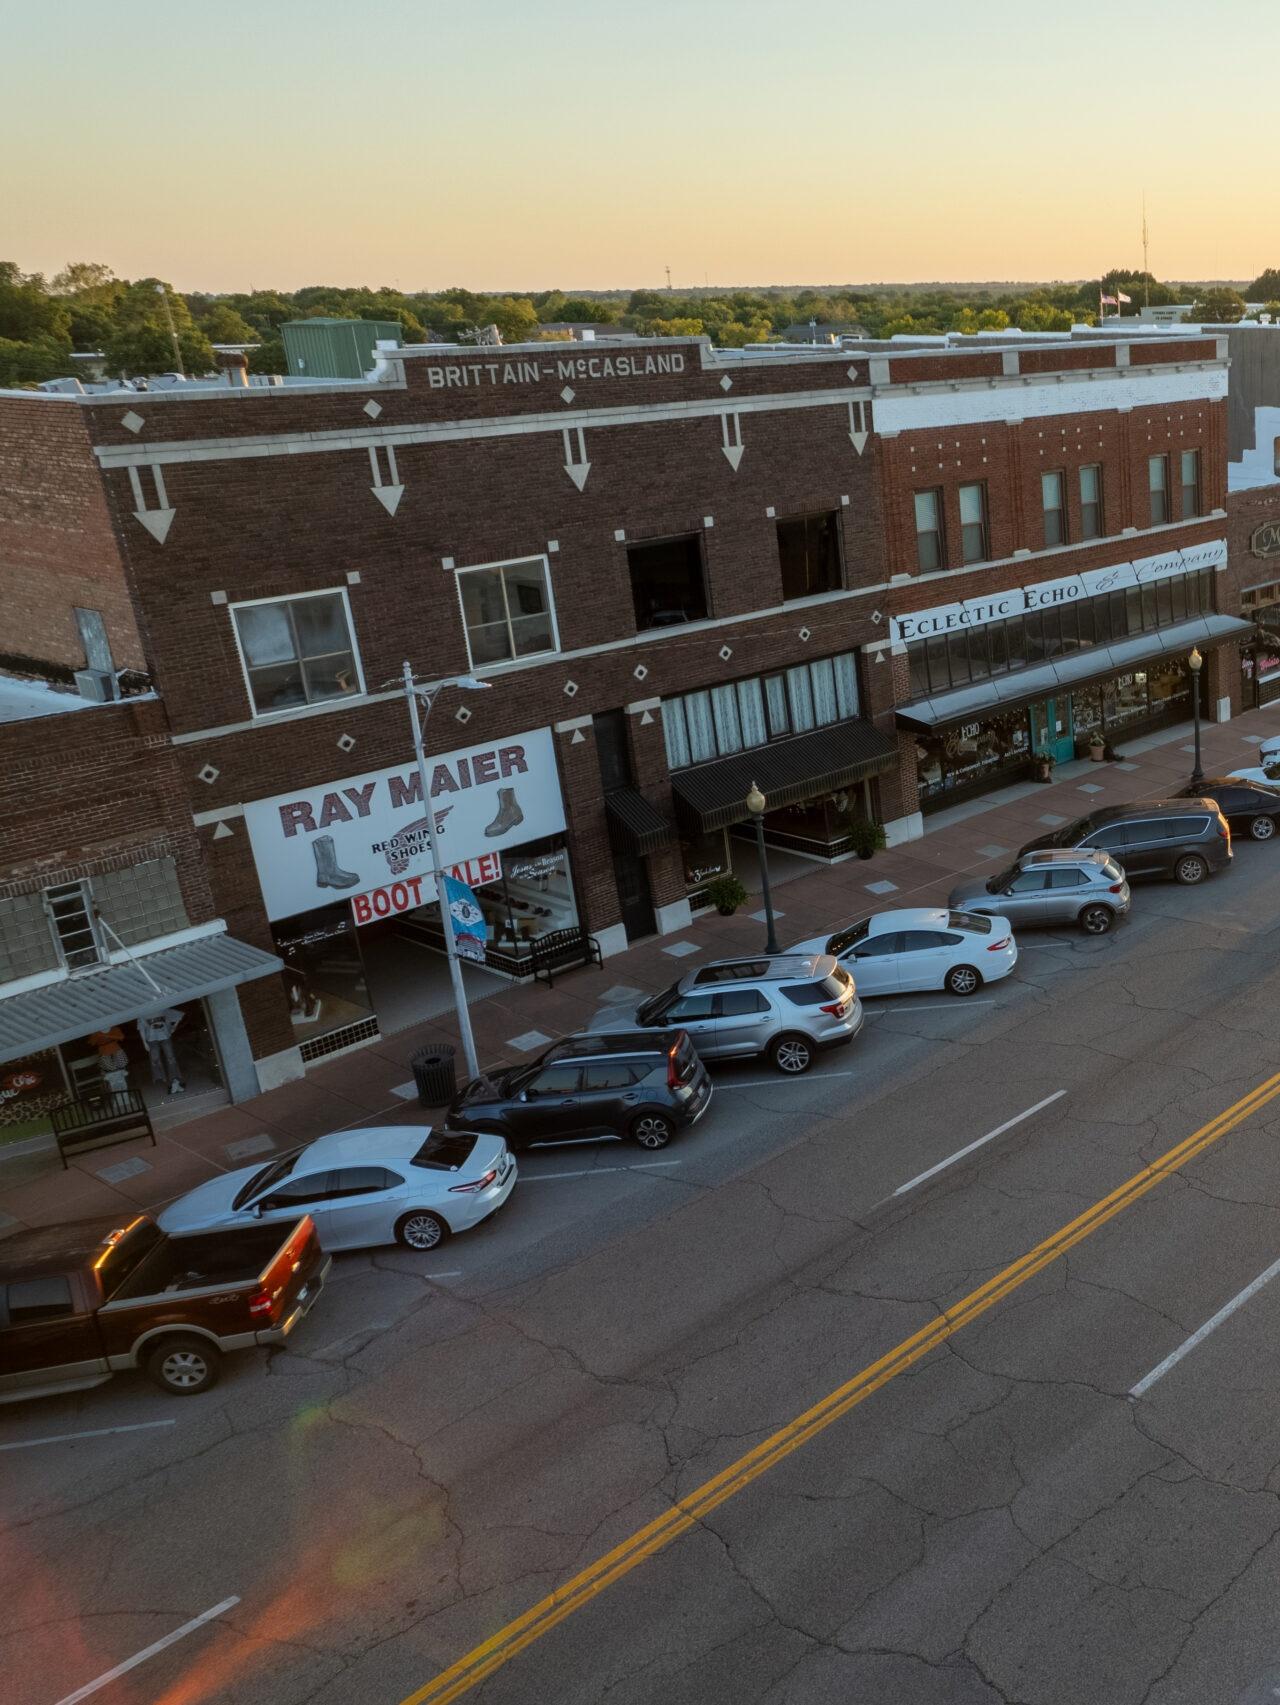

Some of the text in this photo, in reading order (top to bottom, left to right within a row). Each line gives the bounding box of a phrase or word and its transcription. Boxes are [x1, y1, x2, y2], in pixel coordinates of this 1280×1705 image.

[1022, 585, 1079, 609] ECHO
[1136, 549, 1224, 581] Company
[278, 745, 529, 838] RAY MAIER
[371, 824, 445, 854] RED WING
[391, 840, 432, 861] SHOES
[353, 877, 424, 926] BOOT
[436, 852, 499, 897] ALE!
